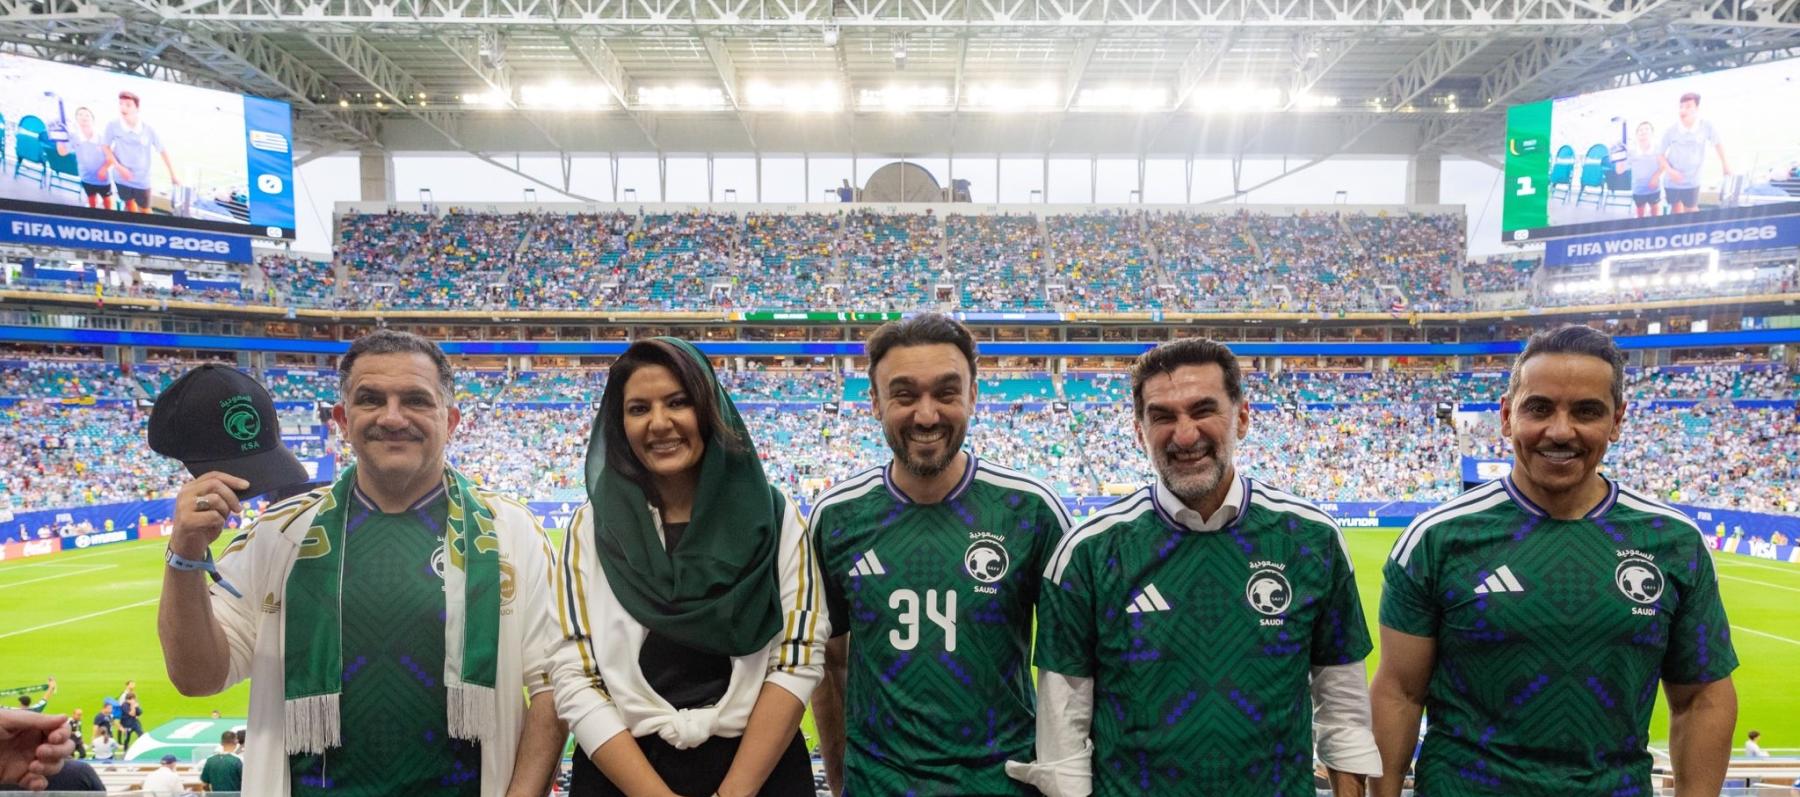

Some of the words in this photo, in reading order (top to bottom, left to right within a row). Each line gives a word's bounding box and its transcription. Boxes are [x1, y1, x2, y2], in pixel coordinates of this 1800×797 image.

[1516, 176, 1536, 196] 1
[11, 220, 55, 239] FIFA
[57, 227, 128, 245] WORLD
[130, 233, 168, 248] CUP
[169, 235, 230, 254] 2026
[1567, 241, 1603, 257] FIFA
[1604, 236, 1668, 254] WORLD
[1670, 233, 1706, 247] CUP
[1709, 225, 1777, 245] 2026
[241, 441, 260, 451] KSA
[969, 531, 1006, 542] السعودية
[1616, 549, 1655, 561] السعودية
[1748, 539, 1777, 560] VISA
[1249, 560, 1286, 571] السعودية
[973, 585, 997, 594] SAUDI
[1631, 607, 1656, 616] SAUDI
[888, 589, 957, 652] 34
